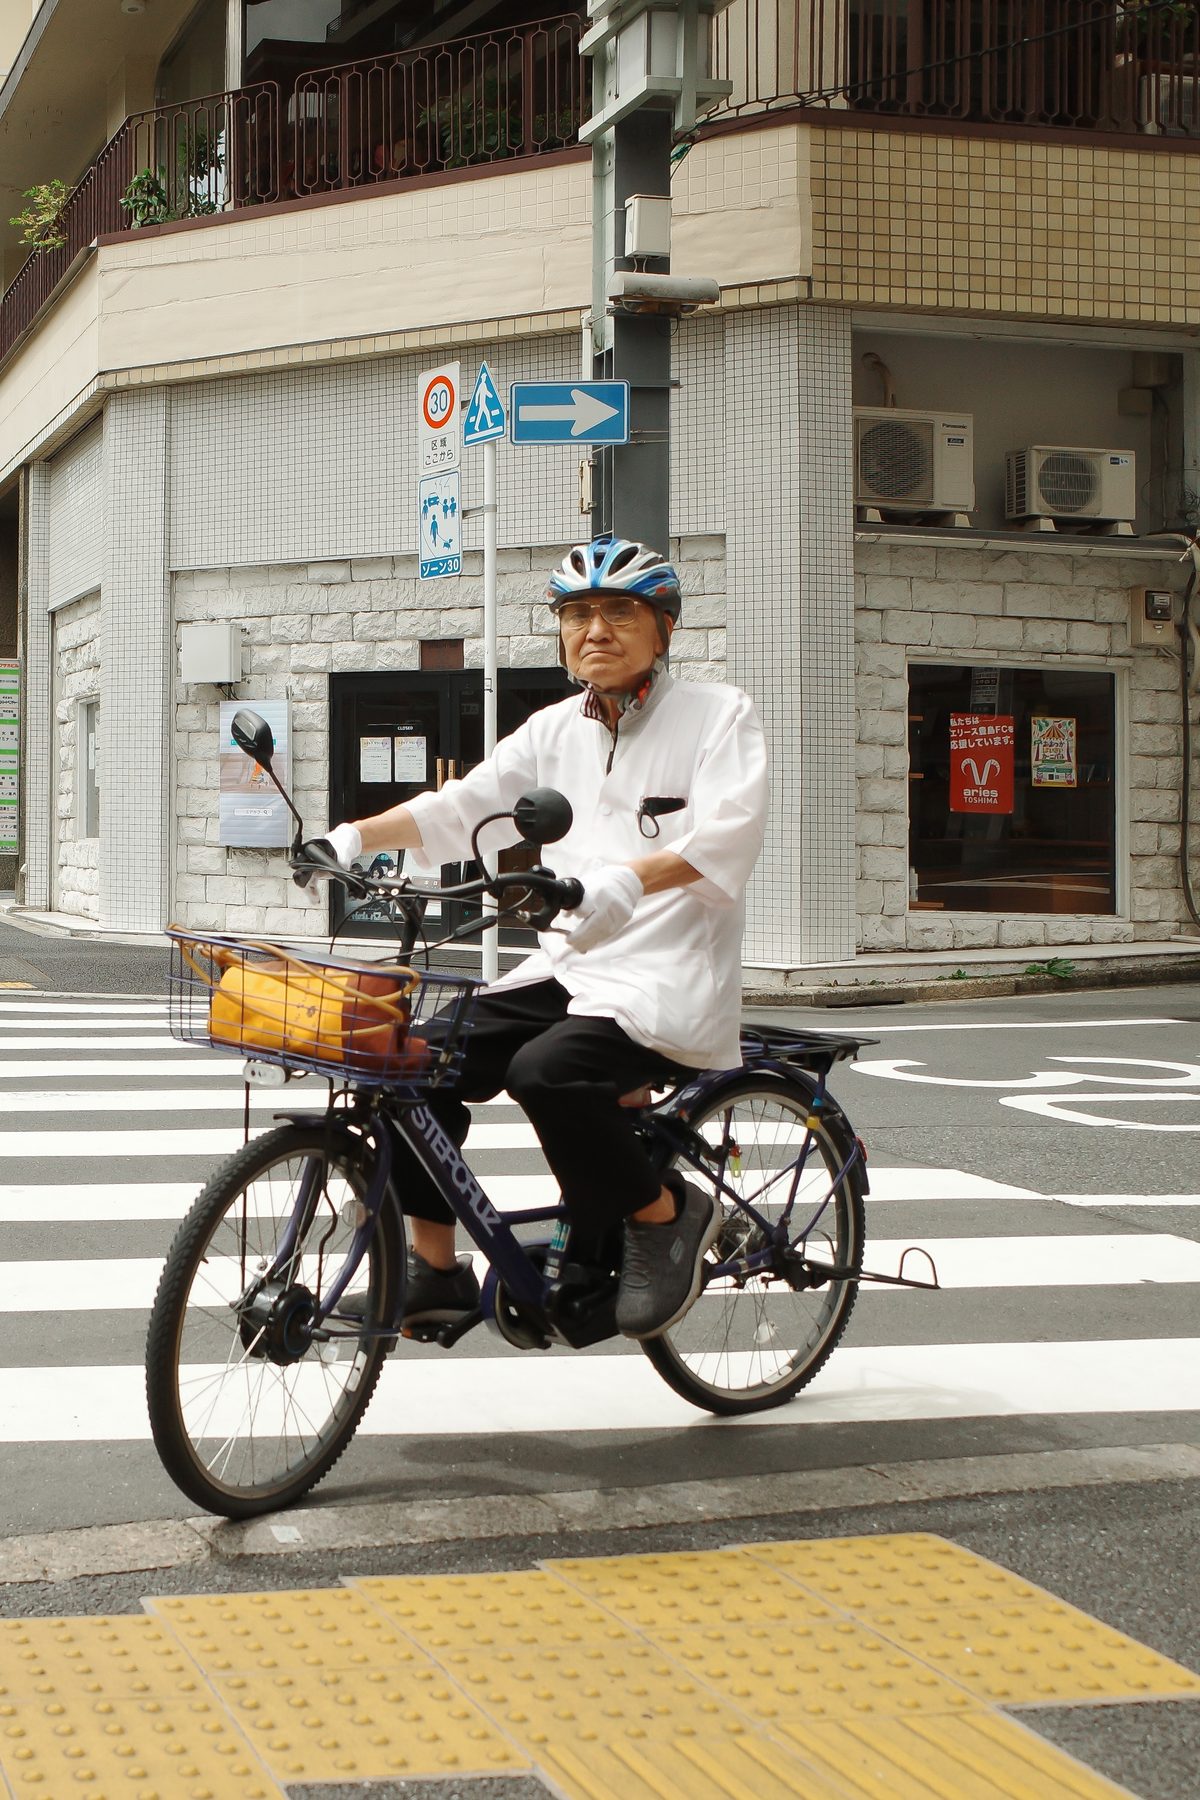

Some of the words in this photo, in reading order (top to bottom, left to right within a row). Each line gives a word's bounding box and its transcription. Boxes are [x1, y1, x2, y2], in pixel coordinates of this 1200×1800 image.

[430, 389, 447, 414] 30
[431, 436, 447, 451] 区域
[425, 449, 454, 466] ここから
[949, 716, 980, 727] 私たちは
[950, 736, 1014, 749] 応援しています。
[963, 786, 999, 798] aries
[964, 796, 999, 805] TOSHIMA
[410, 1103, 502, 1237] STEPCRUZ
